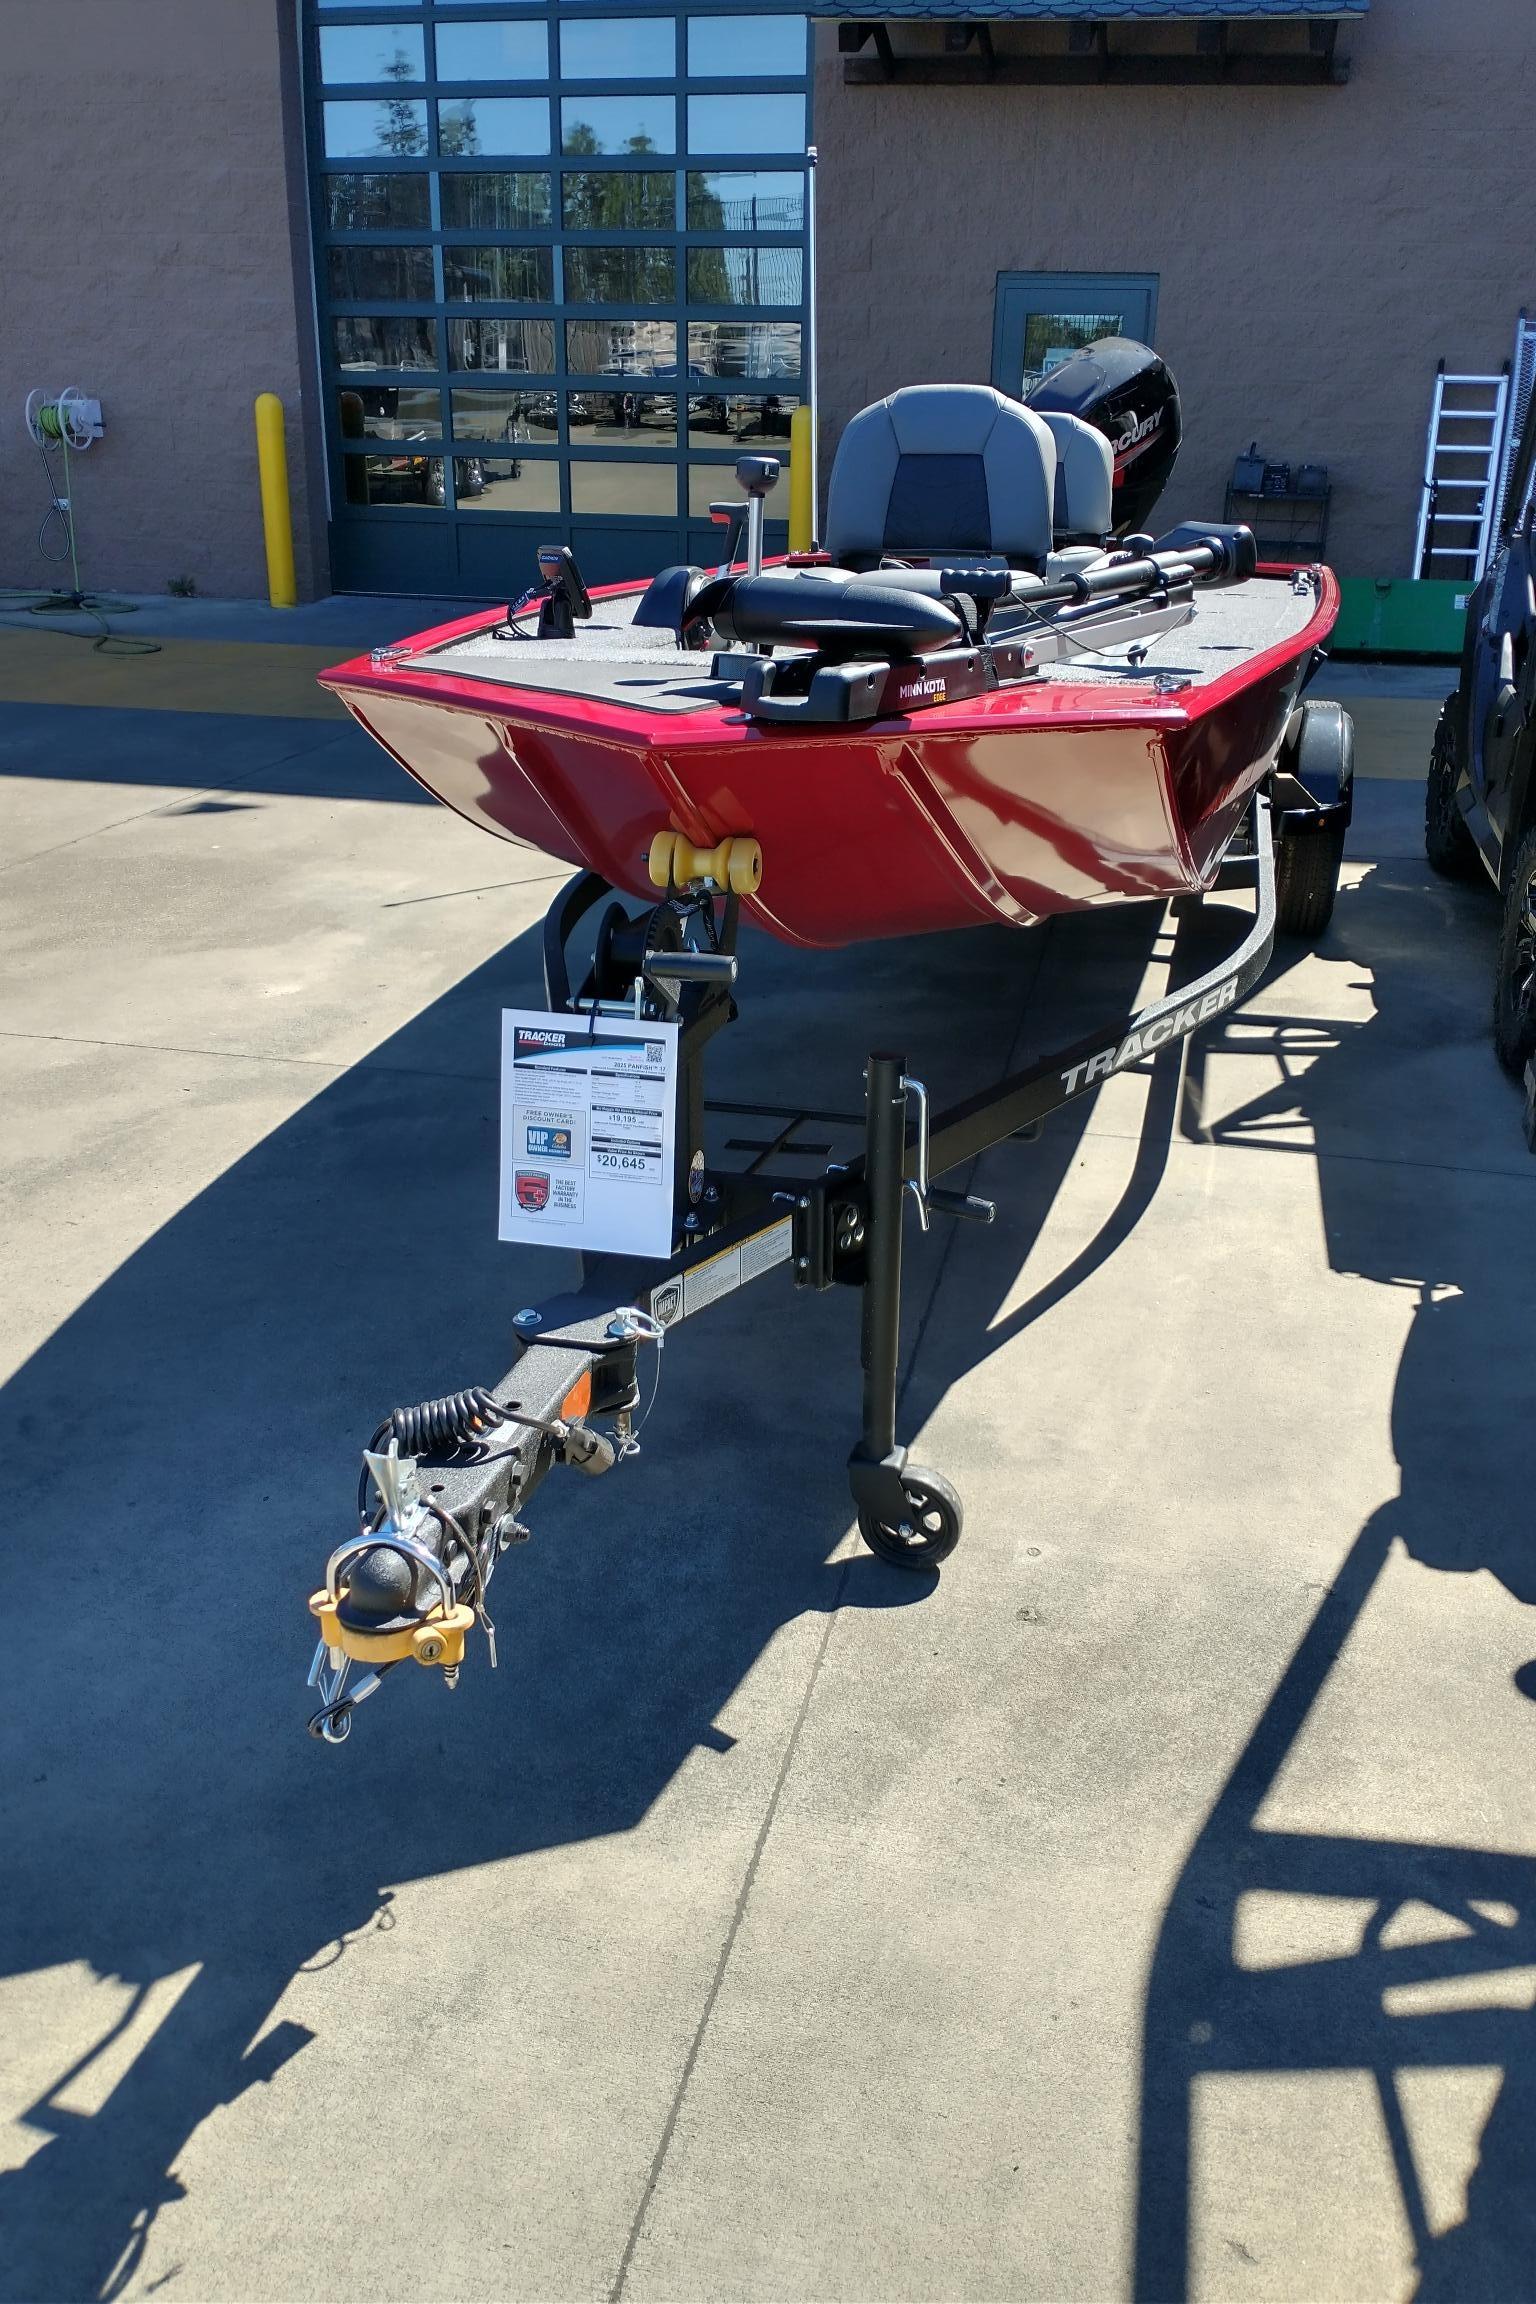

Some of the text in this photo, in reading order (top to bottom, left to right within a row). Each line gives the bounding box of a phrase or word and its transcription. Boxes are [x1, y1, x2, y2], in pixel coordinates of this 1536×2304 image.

[1111, 406, 1164, 454] RCURY
[900, 678, 946, 698] MINN KOTA
[933, 692, 946, 702] EDGE
[518, 1029, 566, 1043] TRACKER
[1060, 974, 1239, 1096] TRACKER
[522, 1115, 555, 1123] DISCOUNT
[609, 1114, 637, 1123] $19,195
[528, 1130, 548, 1145] VIP
[528, 1144, 548, 1152] OWNER
[597, 1154, 646, 1170] $20,645
